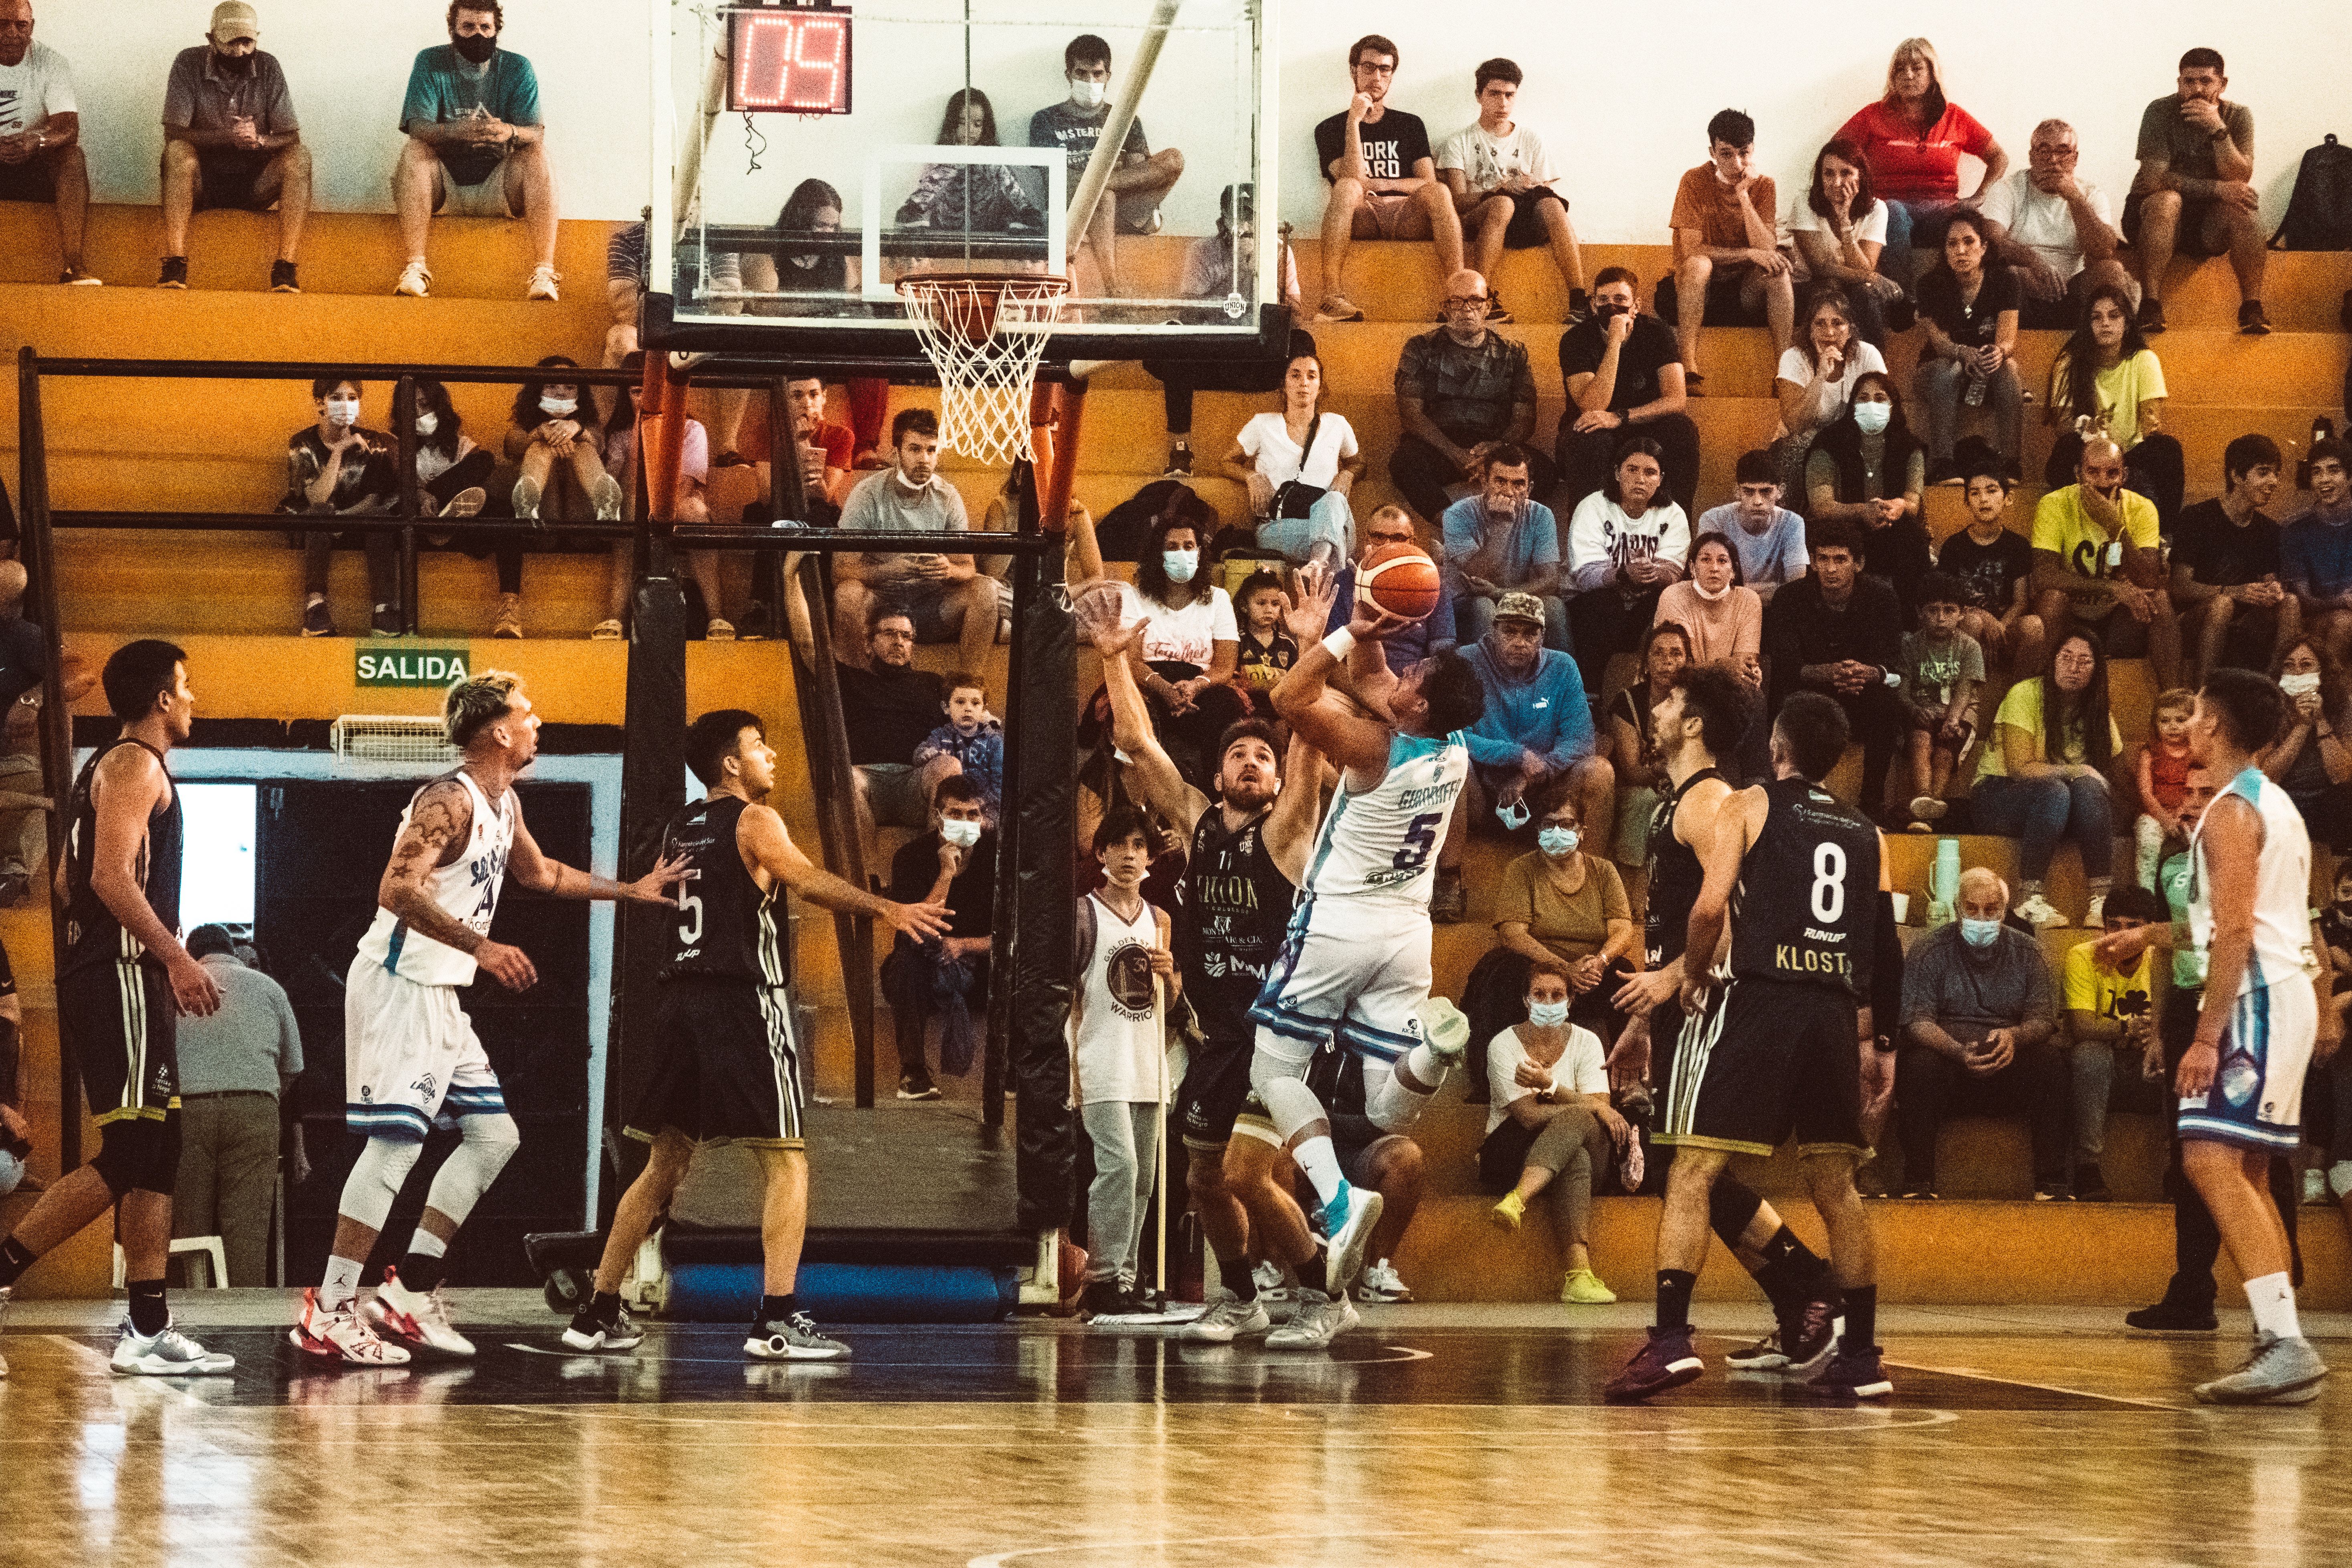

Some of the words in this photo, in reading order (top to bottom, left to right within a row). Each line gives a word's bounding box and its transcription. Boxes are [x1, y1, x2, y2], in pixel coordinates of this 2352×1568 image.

[740, 18, 843, 108] 09
[1224, 301, 1245, 311] UNION
[357, 656, 468, 680] SALIDA
[1392, 812, 1443, 870] 5
[1219, 850, 1232, 871] 11
[1811, 842, 1847, 923] 8
[678, 868, 703, 945] 5
[1104, 936, 1137, 962] GOLDEN
[1803, 927, 1847, 943] RUNUP
[1777, 944, 1849, 975] KLOST
